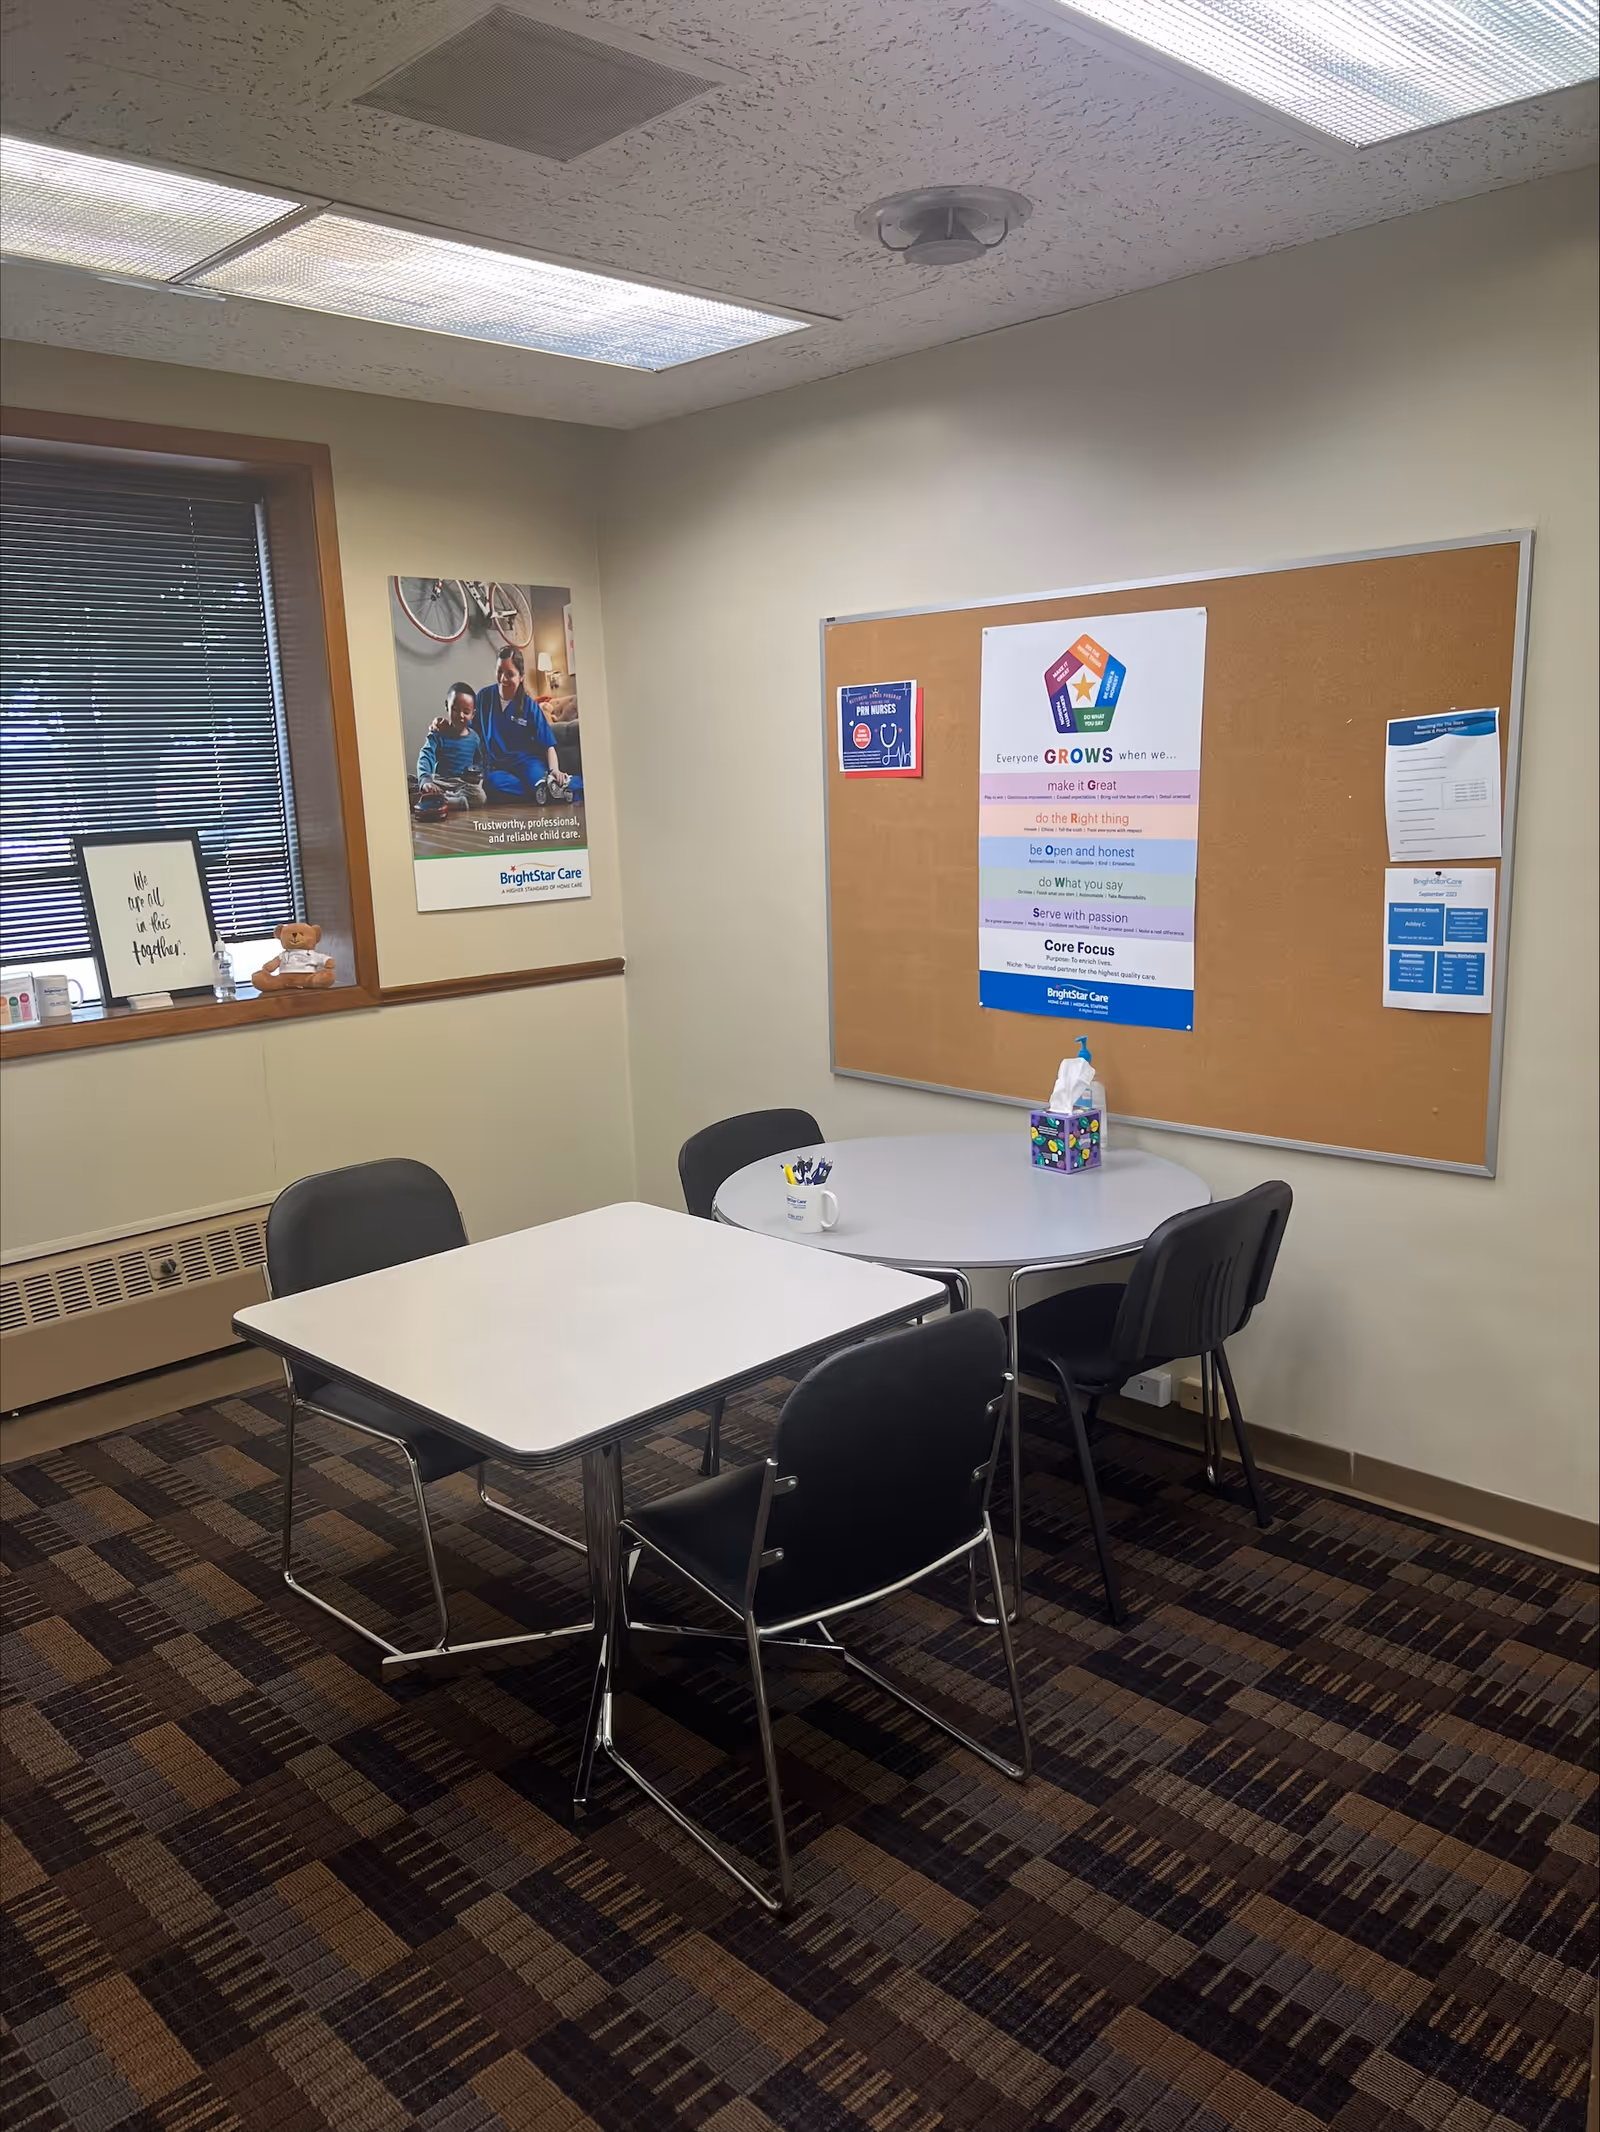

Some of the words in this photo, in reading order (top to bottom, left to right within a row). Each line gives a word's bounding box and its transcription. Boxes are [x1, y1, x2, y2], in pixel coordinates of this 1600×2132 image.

[1052, 664, 1064, 678] MAKE
[1062, 660, 1069, 668] IT
[1056, 668, 1070, 682] GREAT
[856, 705, 870, 716] PRN
[871, 703, 897, 715] NURSES
[996, 753, 1039, 764] Everyone
[1044, 747, 1113, 764] GROWS
[1119, 750, 1147, 760] when
[1151, 751, 1176, 760] we...
[1048, 780, 1074, 791] make
[1078, 780, 1084, 791] it
[1088, 780, 1116, 791] Great
[473, 820, 526, 830] Trustworthy,
[528, 816, 580, 830] professional,
[1036, 812, 1048, 824] do
[1052, 812, 1067, 824] the
[1070, 812, 1098, 826] Right
[1102, 812, 1129, 826] thing
[489, 835, 505, 844] and
[507, 832, 538, 842] reliable
[540, 830, 559, 840] child
[561, 831, 580, 839] care.
[1030, 844, 1042, 855] be
[1045, 845, 1072, 857] Open
[1076, 845, 1095, 856] and
[1098, 846, 1134, 858] honest
[134, 871, 148, 891] We
[500, 870, 555, 886] BrightStar
[558, 867, 582, 879] Care
[1039, 876, 1052, 887] do
[1054, 877, 1081, 888] What
[1084, 880, 1102, 891] you
[1106, 881, 1123, 892] say
[525, 885, 548, 893] STANDARD
[128, 894, 145, 912] are
[148, 887, 164, 908] all
[136, 918, 148, 933] in
[150, 912, 171, 934] this
[1033, 907, 1061, 919] Serve
[1064, 909, 1085, 920] with
[1088, 912, 1128, 923] passion
[132, 936, 186, 966] together.
[1044, 939, 1074, 953] Core
[1078, 941, 1115, 956] Focus
[1098, 969, 1119, 977] highest
[1120, 972, 1141, 980] quality
[1047, 987, 1088, 1000] BrightStar
[1089, 992, 1108, 1003] Care
